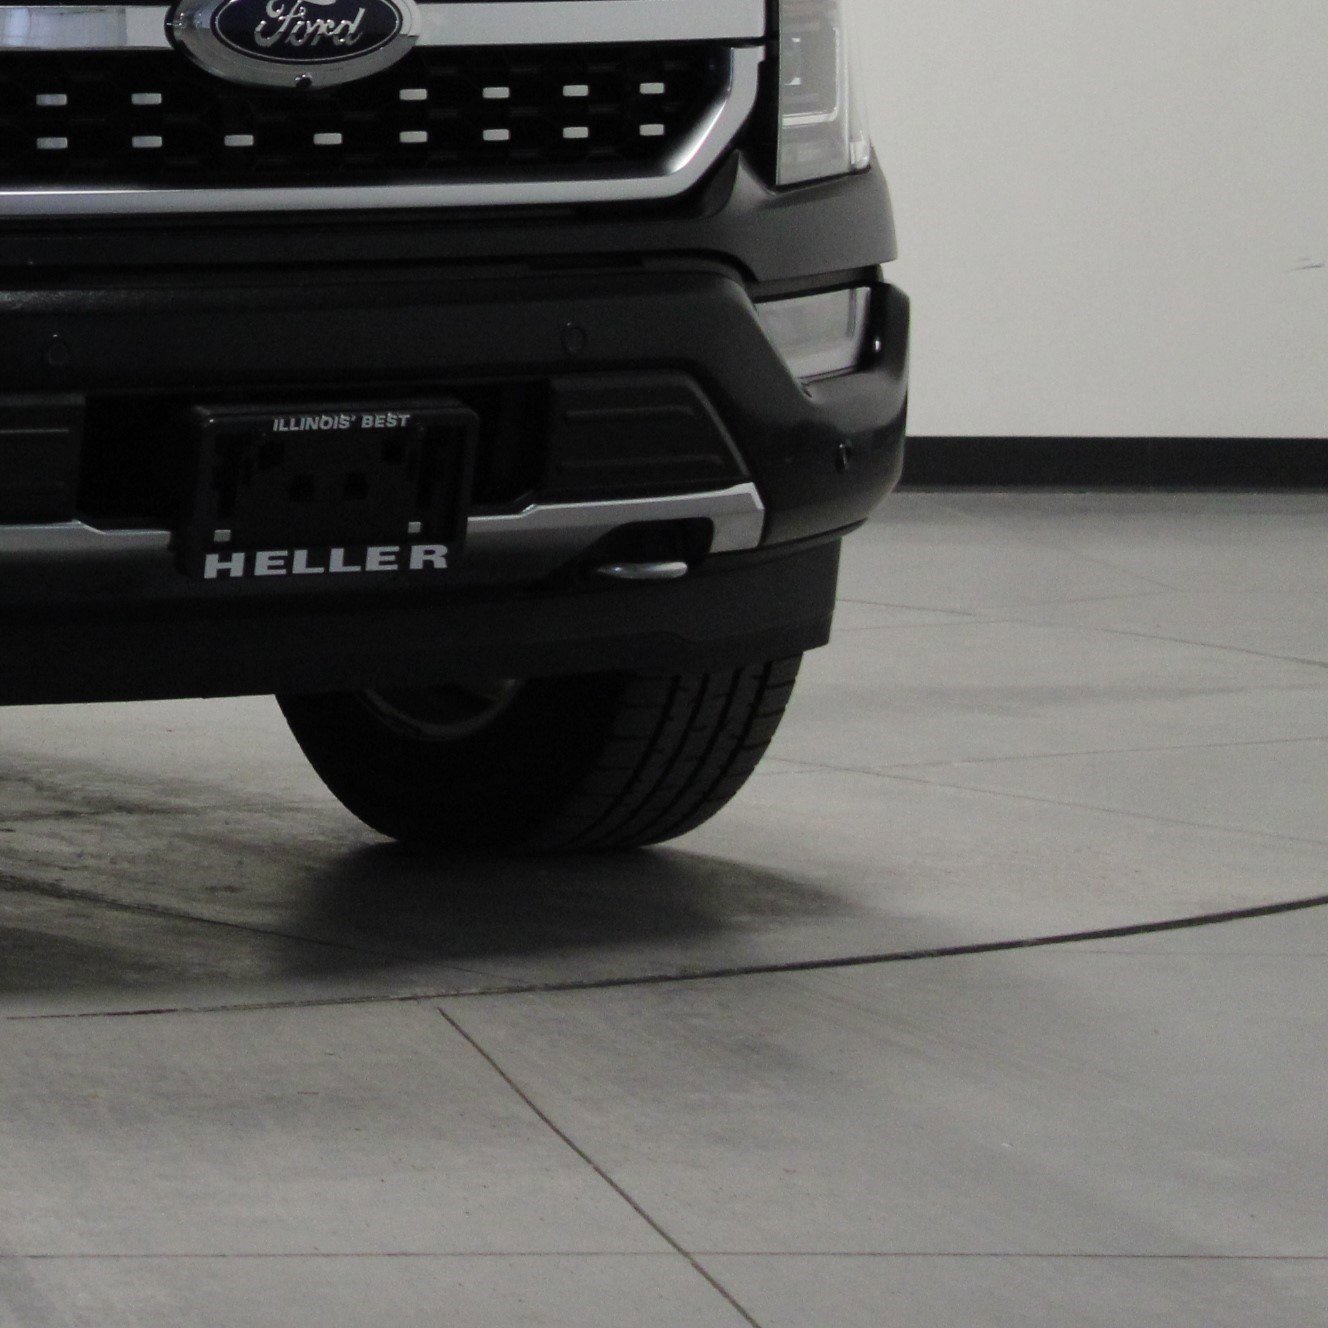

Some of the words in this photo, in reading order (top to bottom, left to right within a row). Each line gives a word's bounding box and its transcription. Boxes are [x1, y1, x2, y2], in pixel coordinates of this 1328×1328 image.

[272, 413, 357, 432] ILLINOIS'
[360, 412, 411, 429] BEST
[203, 544, 449, 580] HELLER
